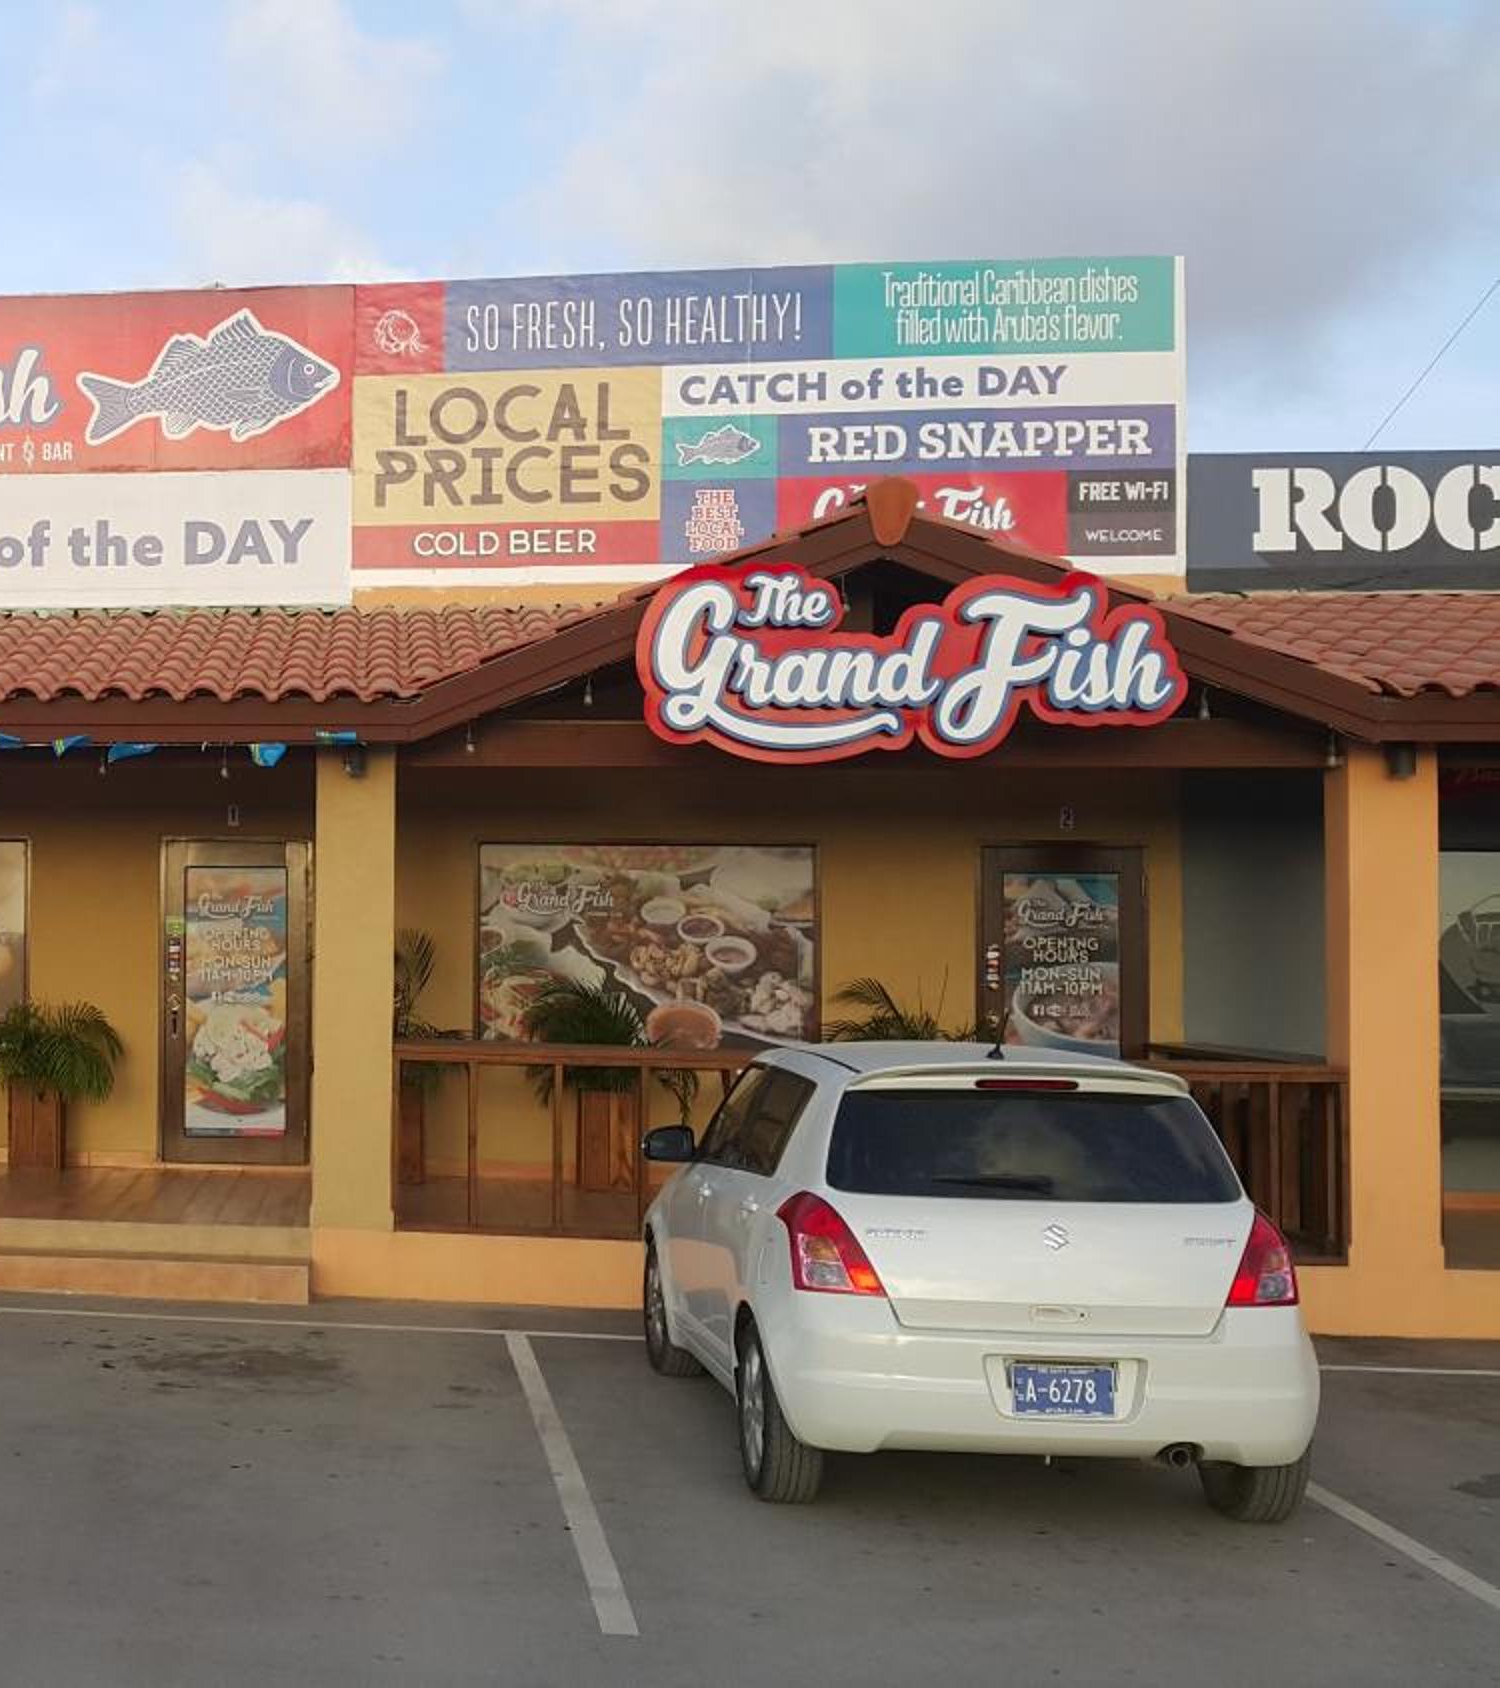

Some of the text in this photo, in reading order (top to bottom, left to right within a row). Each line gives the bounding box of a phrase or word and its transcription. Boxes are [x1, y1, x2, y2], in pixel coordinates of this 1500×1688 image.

[881, 268, 1139, 307] Traditional Caribbean dishes
[467, 292, 801, 351] SO FRESH, SO HEALTHY!
[897, 305, 1123, 344] filled with Aruba's flavor.
[679, 365, 1069, 406] CATCH of the DAY
[395, 382, 630, 446] LOCAL
[43, 442, 73, 463] BAR
[808, 419, 1152, 463] RED SNAPPER
[374, 443, 651, 507] PRICES
[695, 489, 735, 505] THE
[1079, 480, 1168, 501] FREE WI-FI
[691, 504, 739, 520] BEST
[934, 484, 1016, 530] Fish
[685, 520, 745, 537] LOCAL
[1085, 528, 1162, 543] WELCOME
[68, 520, 164, 567] the
[184, 519, 314, 566] DAY
[414, 529, 596, 556] COLD BEER
[690, 536, 739, 552] FOOD
[740, 573, 831, 625] The
[657, 582, 1173, 748] Grand Fish
[1023, 936, 1099, 951] OPENING
[1033, 949, 1089, 963] HOURS
[1021, 967, 1101, 981] MON-SUN
[1020, 981, 1103, 995] 11AM-10PM
[1026, 1378, 1097, 1404] A-6278
